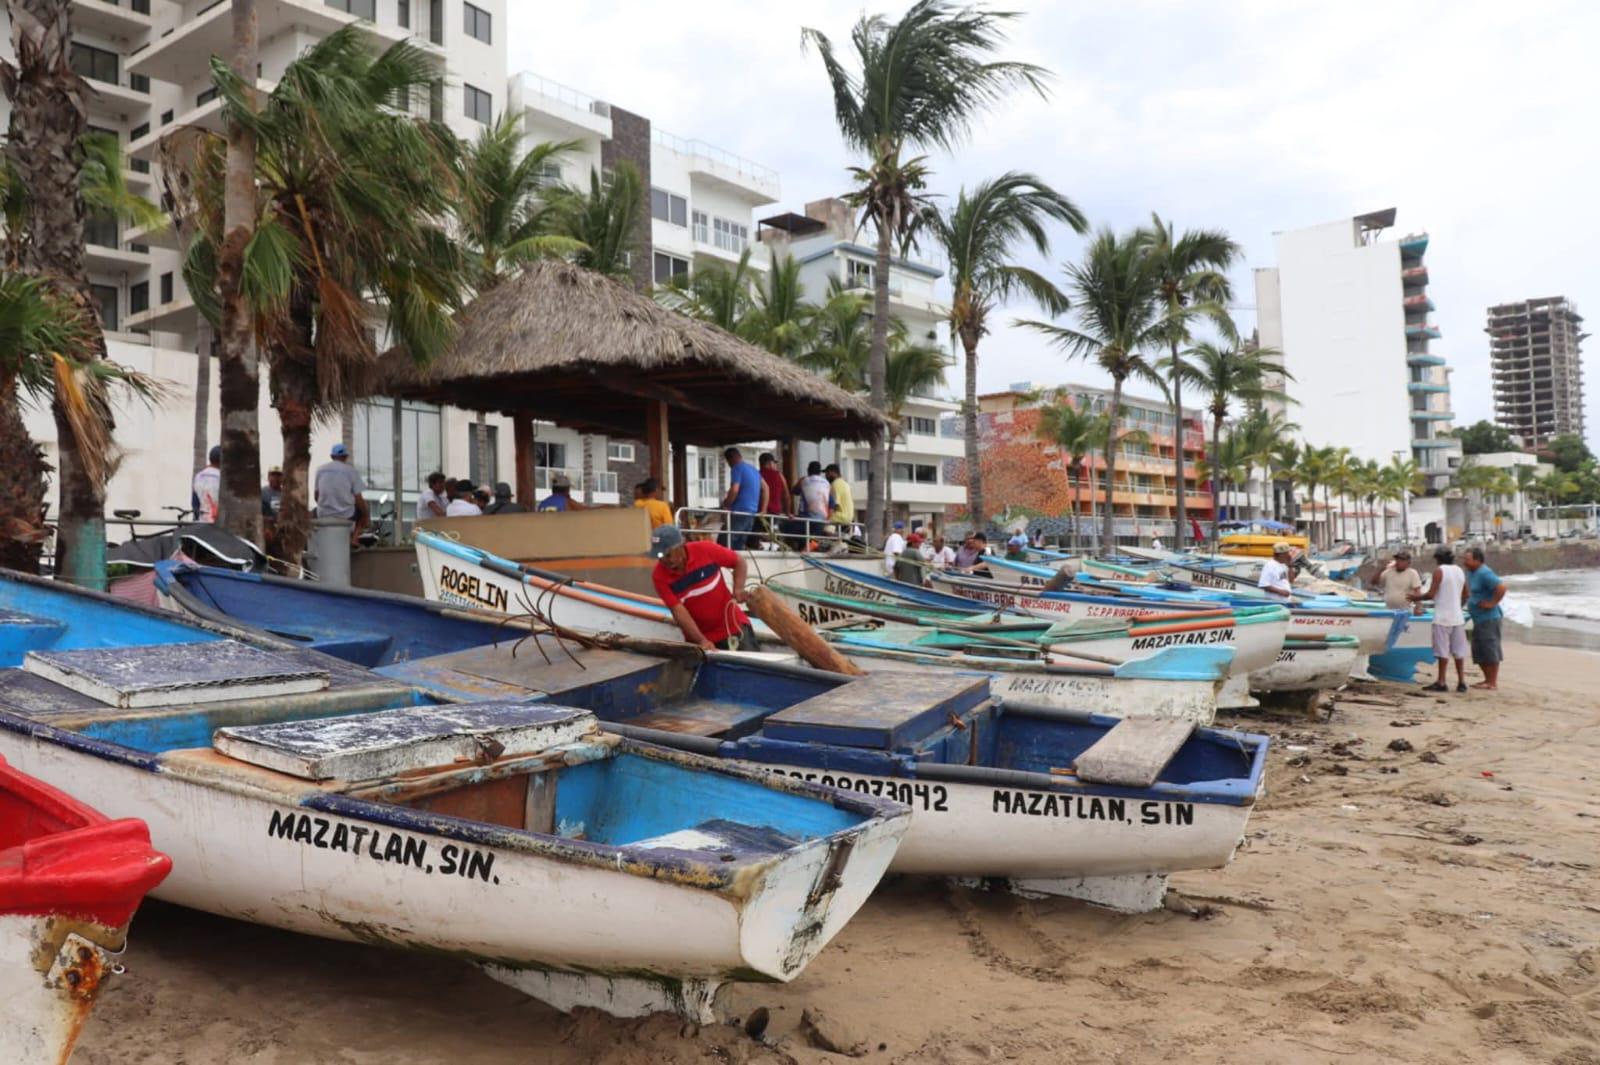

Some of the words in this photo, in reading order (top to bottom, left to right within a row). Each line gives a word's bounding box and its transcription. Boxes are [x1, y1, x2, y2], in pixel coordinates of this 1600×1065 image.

[440, 564, 508, 612] ROGELIN
[992, 789, 1132, 826] MAZATLAN,
[1140, 802, 1194, 826] SIN
[268, 809, 434, 874] MAZATLAN,
[439, 844, 500, 886] SIN.
